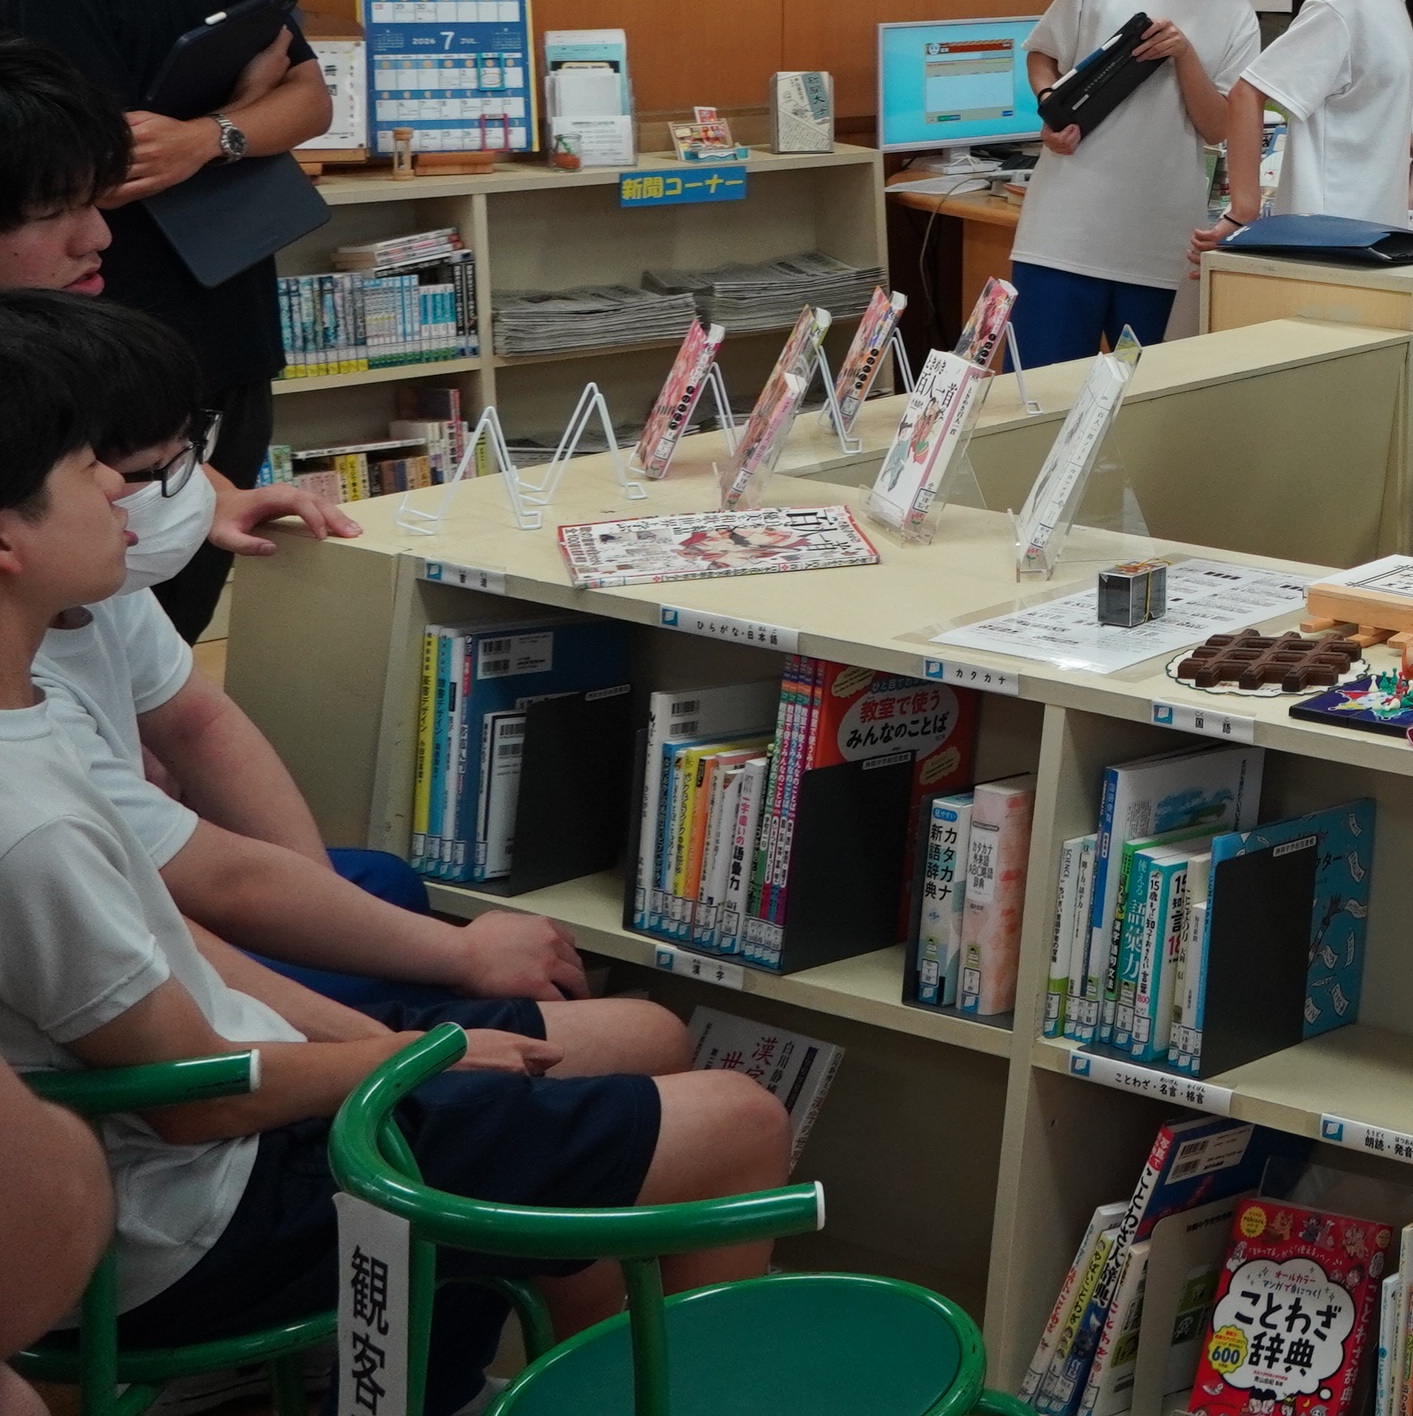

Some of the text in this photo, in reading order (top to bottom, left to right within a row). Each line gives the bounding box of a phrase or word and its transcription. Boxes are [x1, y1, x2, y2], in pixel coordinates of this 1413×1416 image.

[440, 32, 455, 51] 7
[621, 174, 744, 200] 新聞コーナー
[697, 621, 779, 645] ひらがな・日本語
[956, 668, 1006, 685] カタカナ
[860, 690, 942, 724] 教室で使う
[845, 711, 950, 750] みんなのことば
[1195, 717, 1232, 735] 国語
[729, 797, 750, 891] 一字違いの語彙力
[925, 823, 943, 899] 新語辞典
[938, 826, 958, 902] カタカナ
[1135, 859, 1147, 897] 使える
[1122, 900, 1145, 979] 語彙力
[1115, 1073, 1205, 1105] ことわざ・名言・格言
[1275, 1271, 1316, 1284] オールカラー
[1234, 1291, 1342, 1342] ことわざ
[1211, 1346, 1241, 1364] 600
[1249, 1331, 1315, 1376] 辞典
